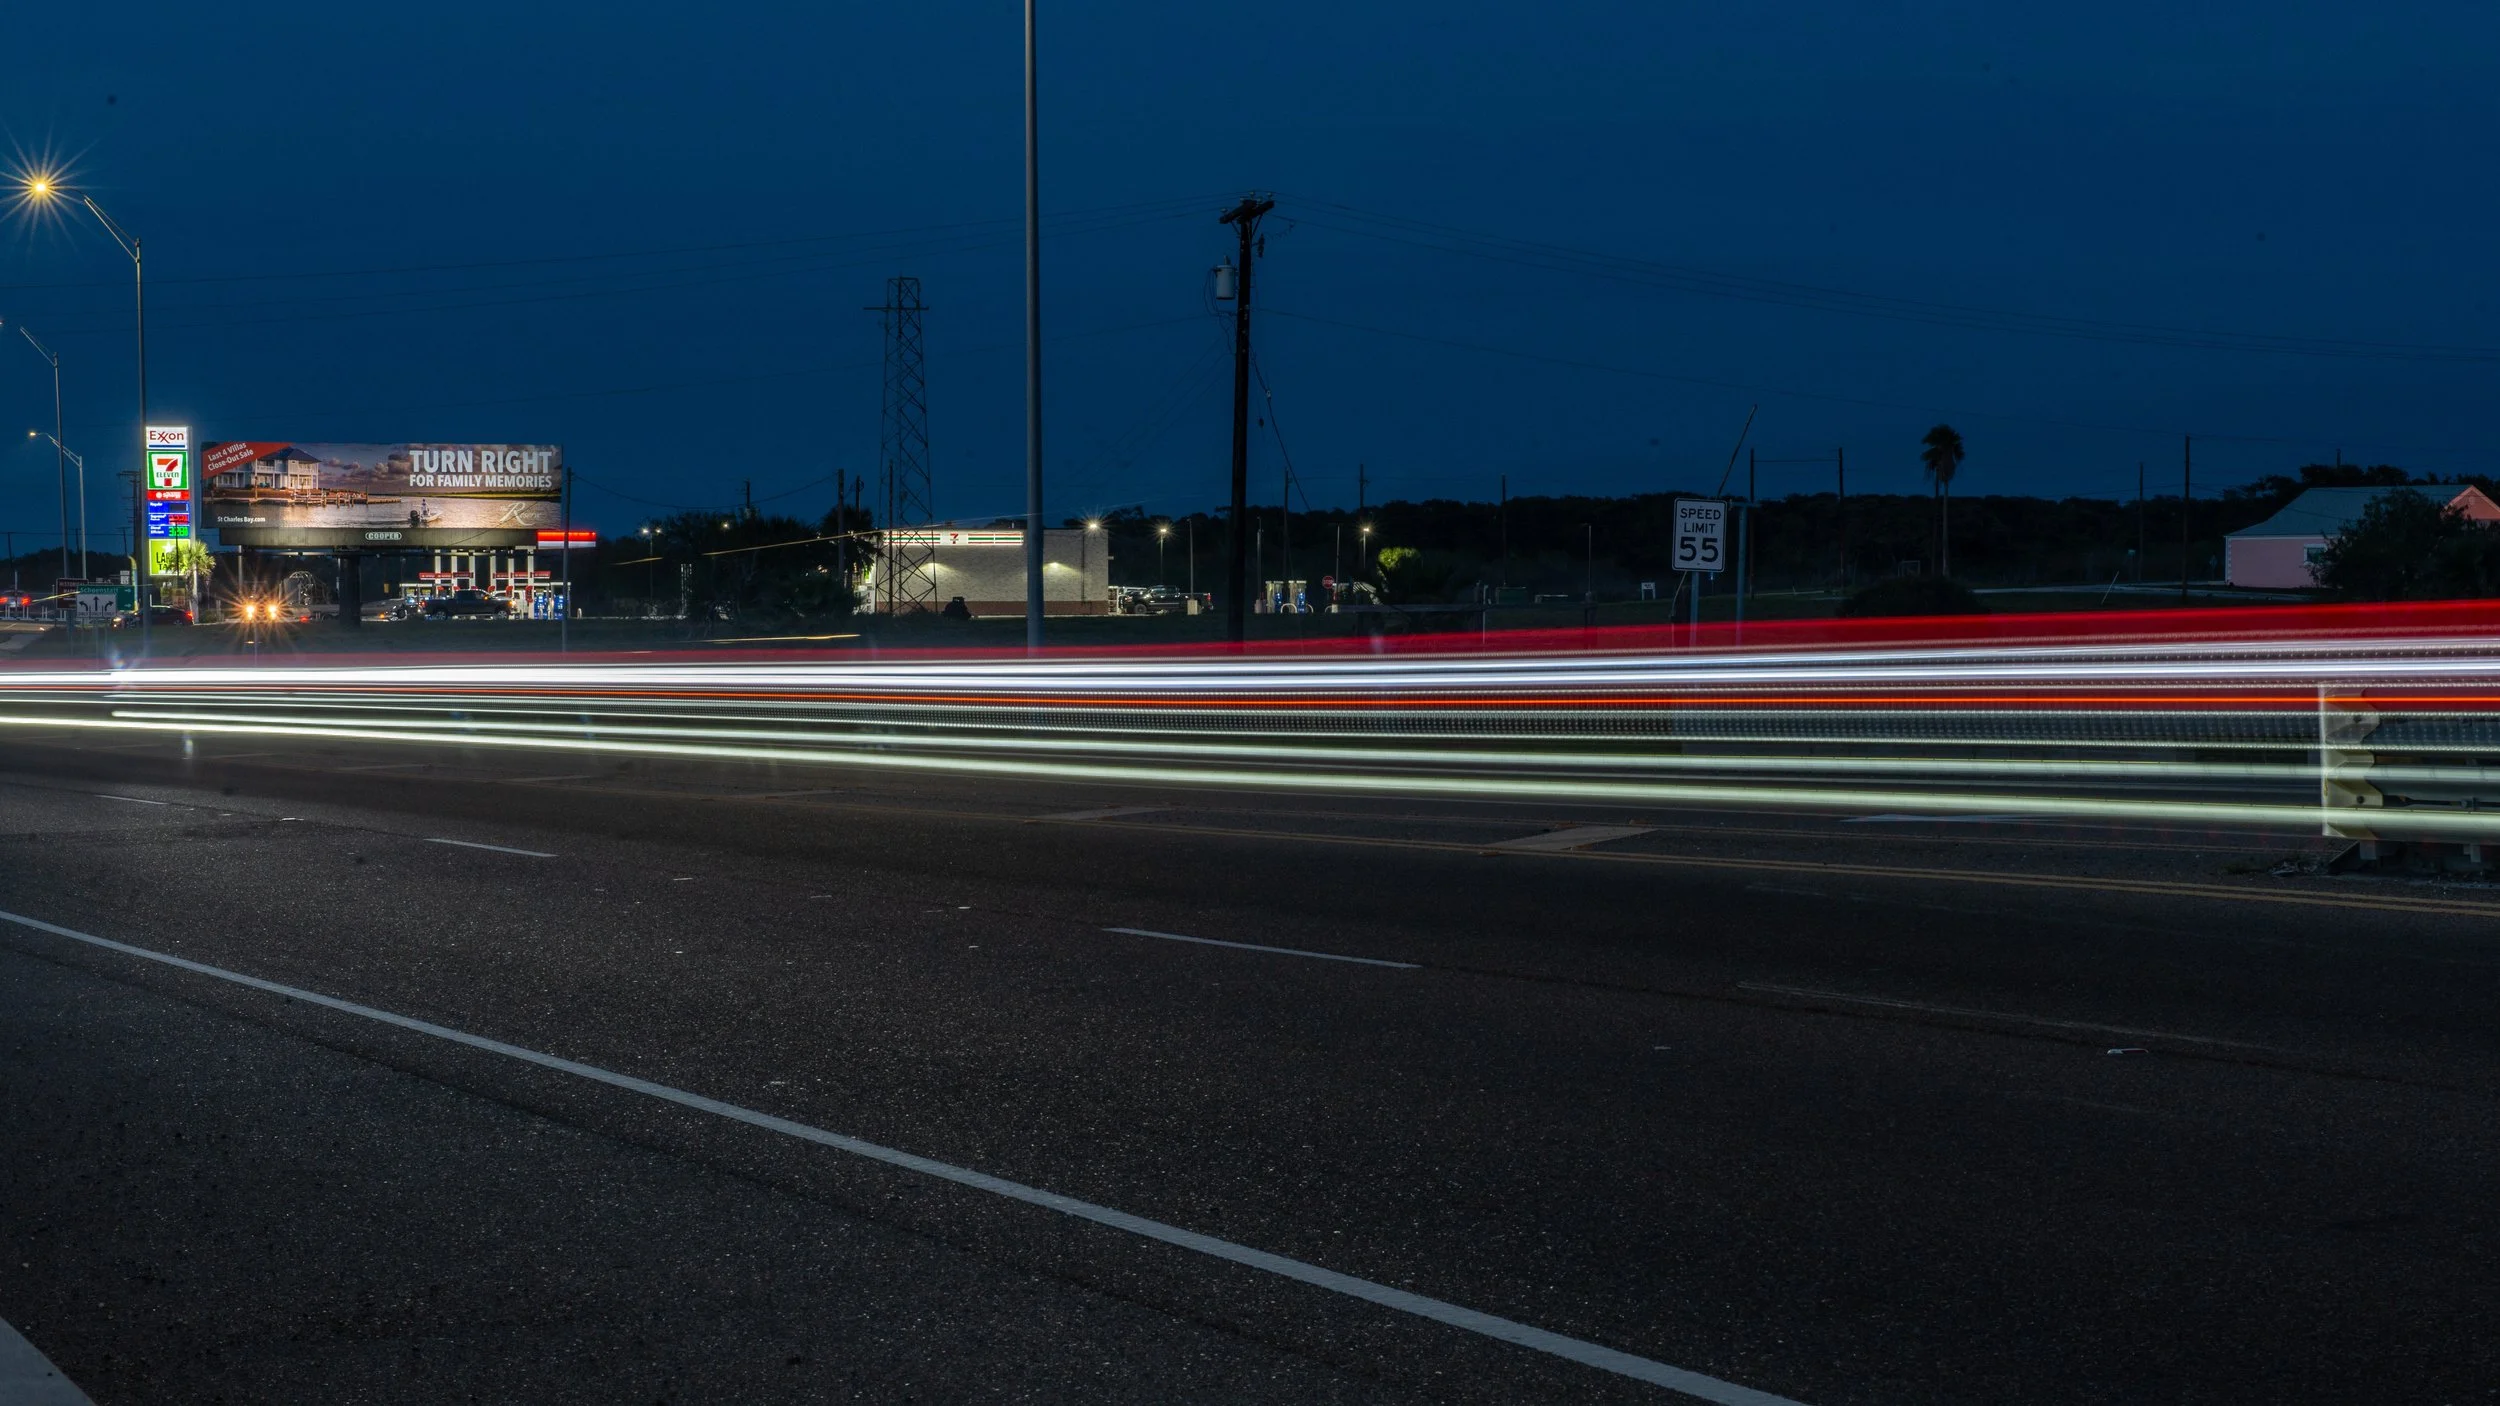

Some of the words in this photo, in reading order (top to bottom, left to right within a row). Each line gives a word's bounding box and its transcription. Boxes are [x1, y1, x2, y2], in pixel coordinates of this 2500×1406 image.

[149, 430, 185, 444] Exxon
[207, 451, 222, 462] Last
[227, 442, 247, 453] Villas
[207, 456, 239, 471] Close-Out
[239, 448, 254, 459] Sale
[409, 450, 474, 473] TURN
[481, 450, 552, 474] RIGHT
[157, 458, 179, 487] 7
[409, 474, 435, 487] FOR
[437, 474, 483, 487] FAMILY
[485, 475, 552, 488] MEMORIES
[244, 516, 266, 524] Bay.com
[1680, 507, 1722, 520] SPEED
[1683, 522, 1716, 534] LIMIT
[368, 532, 400, 541] COOPER
[1679, 536, 1719, 563] 55
